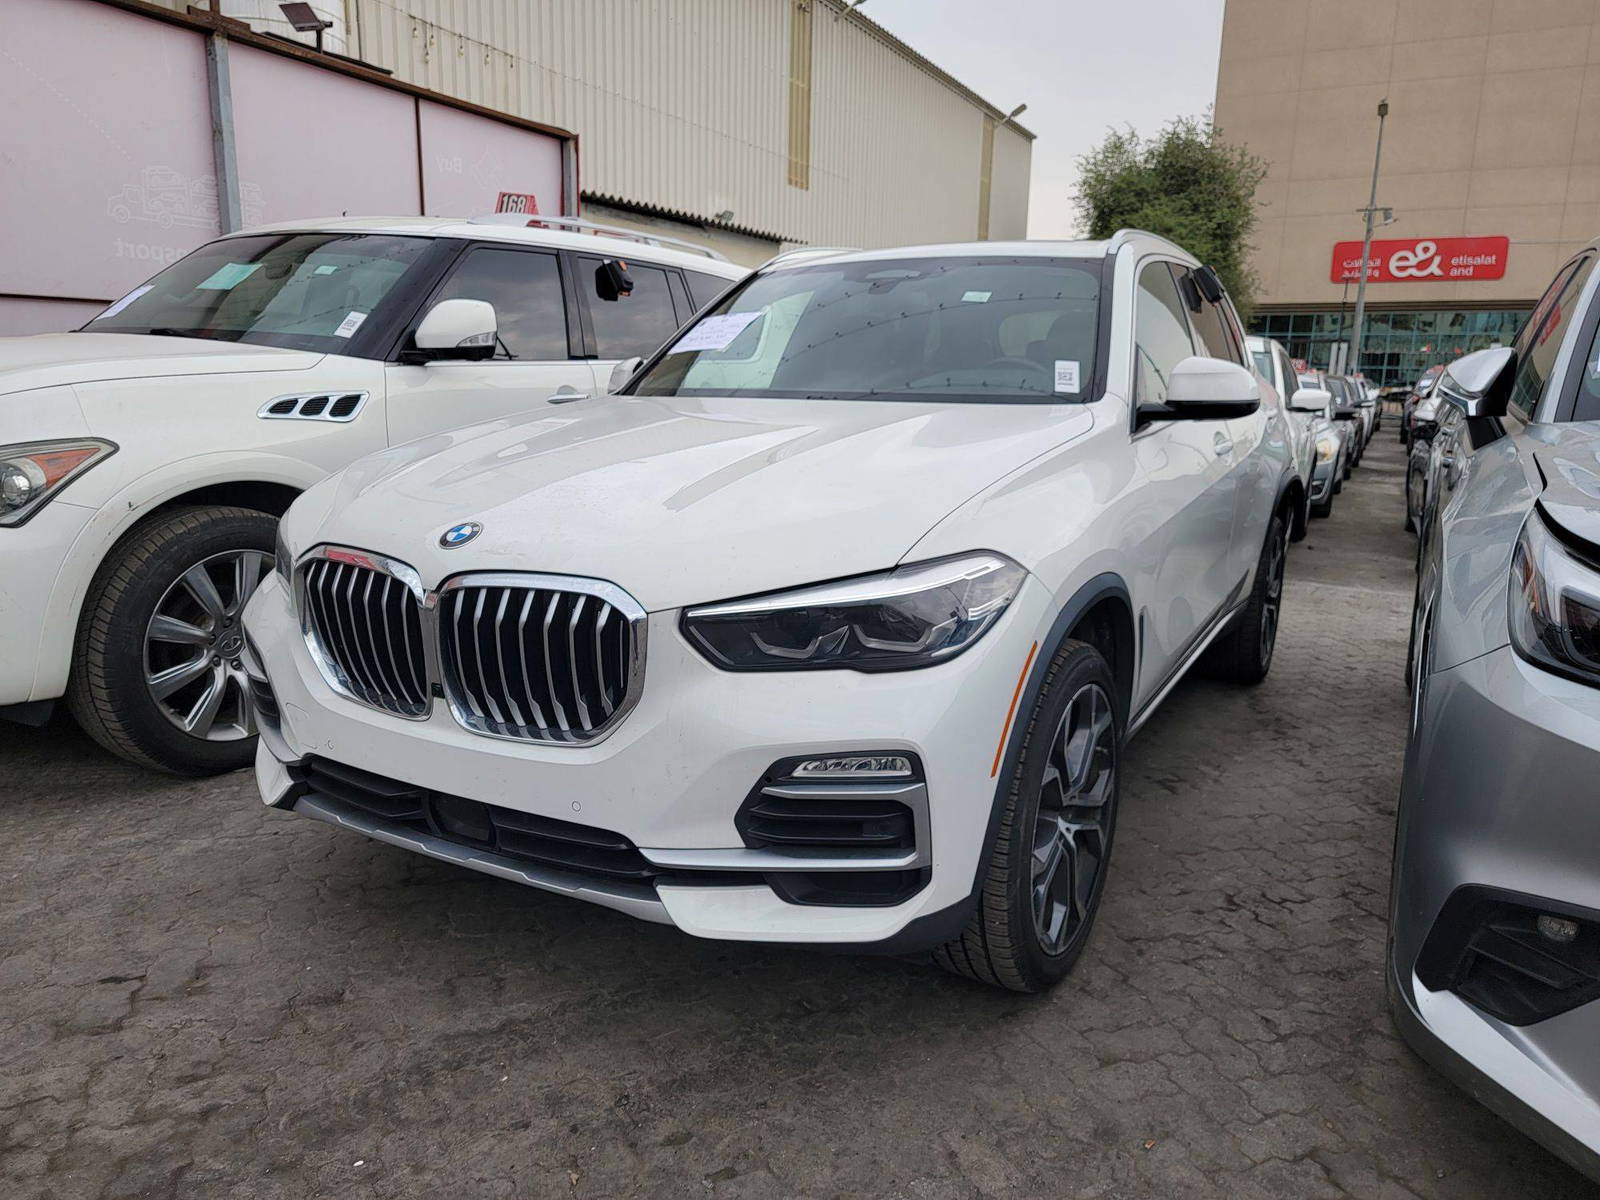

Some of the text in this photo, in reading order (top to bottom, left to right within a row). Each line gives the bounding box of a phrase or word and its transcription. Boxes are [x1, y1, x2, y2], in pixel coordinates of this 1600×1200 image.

[501, 194, 526, 213] 168
[1389, 241, 1444, 277] e&
[1451, 254, 1496, 266] etisalat
[1450, 266, 1473, 276] and
